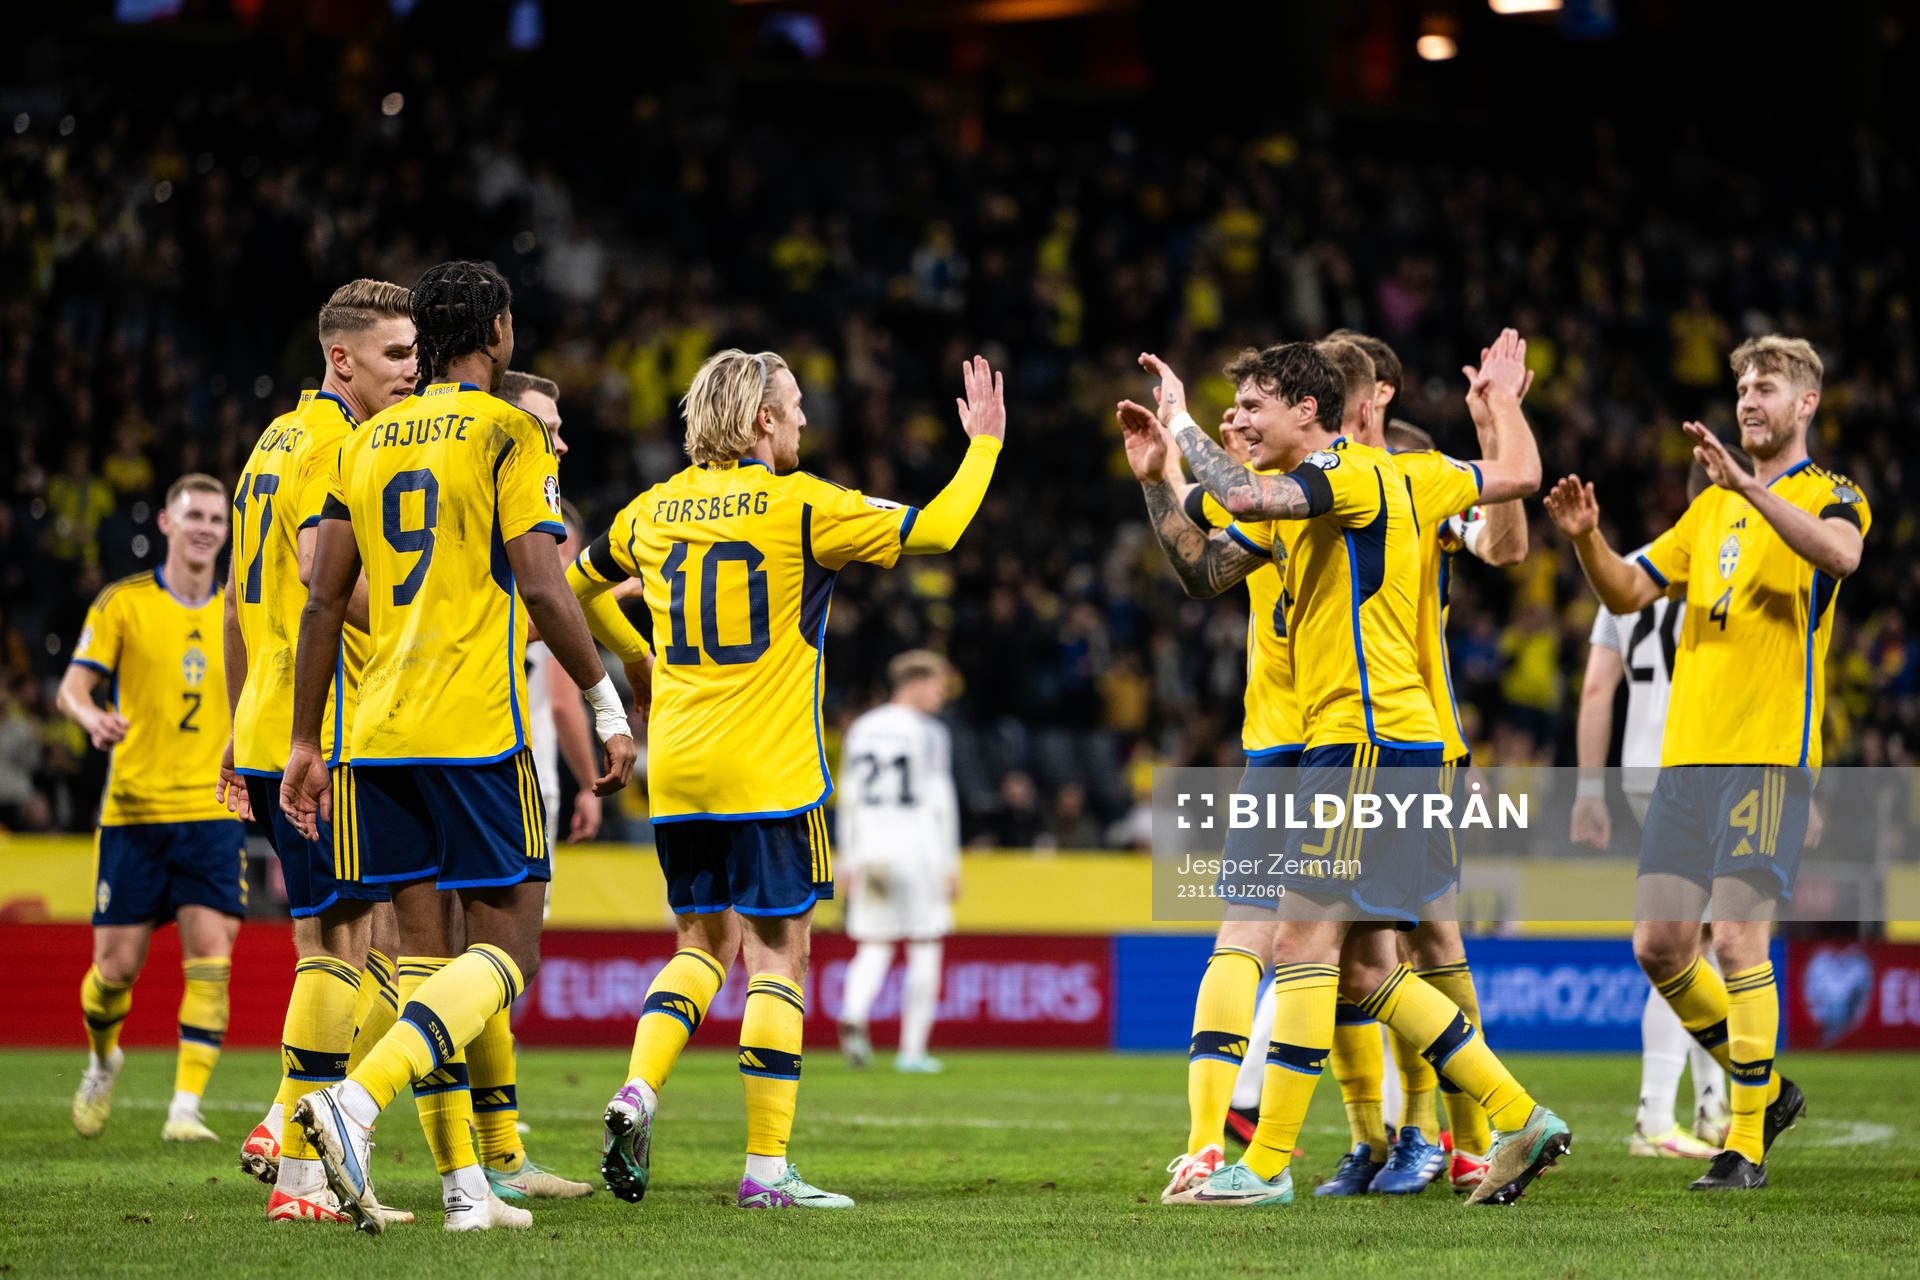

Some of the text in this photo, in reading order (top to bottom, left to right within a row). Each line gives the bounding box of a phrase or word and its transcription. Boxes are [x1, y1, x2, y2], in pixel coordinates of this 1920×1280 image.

[371, 414, 475, 449] CAJUSTE
[653, 491, 769, 523] FORSBERG
[382, 467, 440, 607] 9
[660, 541, 771, 666] 10
[1709, 586, 1733, 631] 4
[179, 691, 202, 733] 2
[849, 752, 919, 807] 21
[1730, 789, 1759, 836] 4
